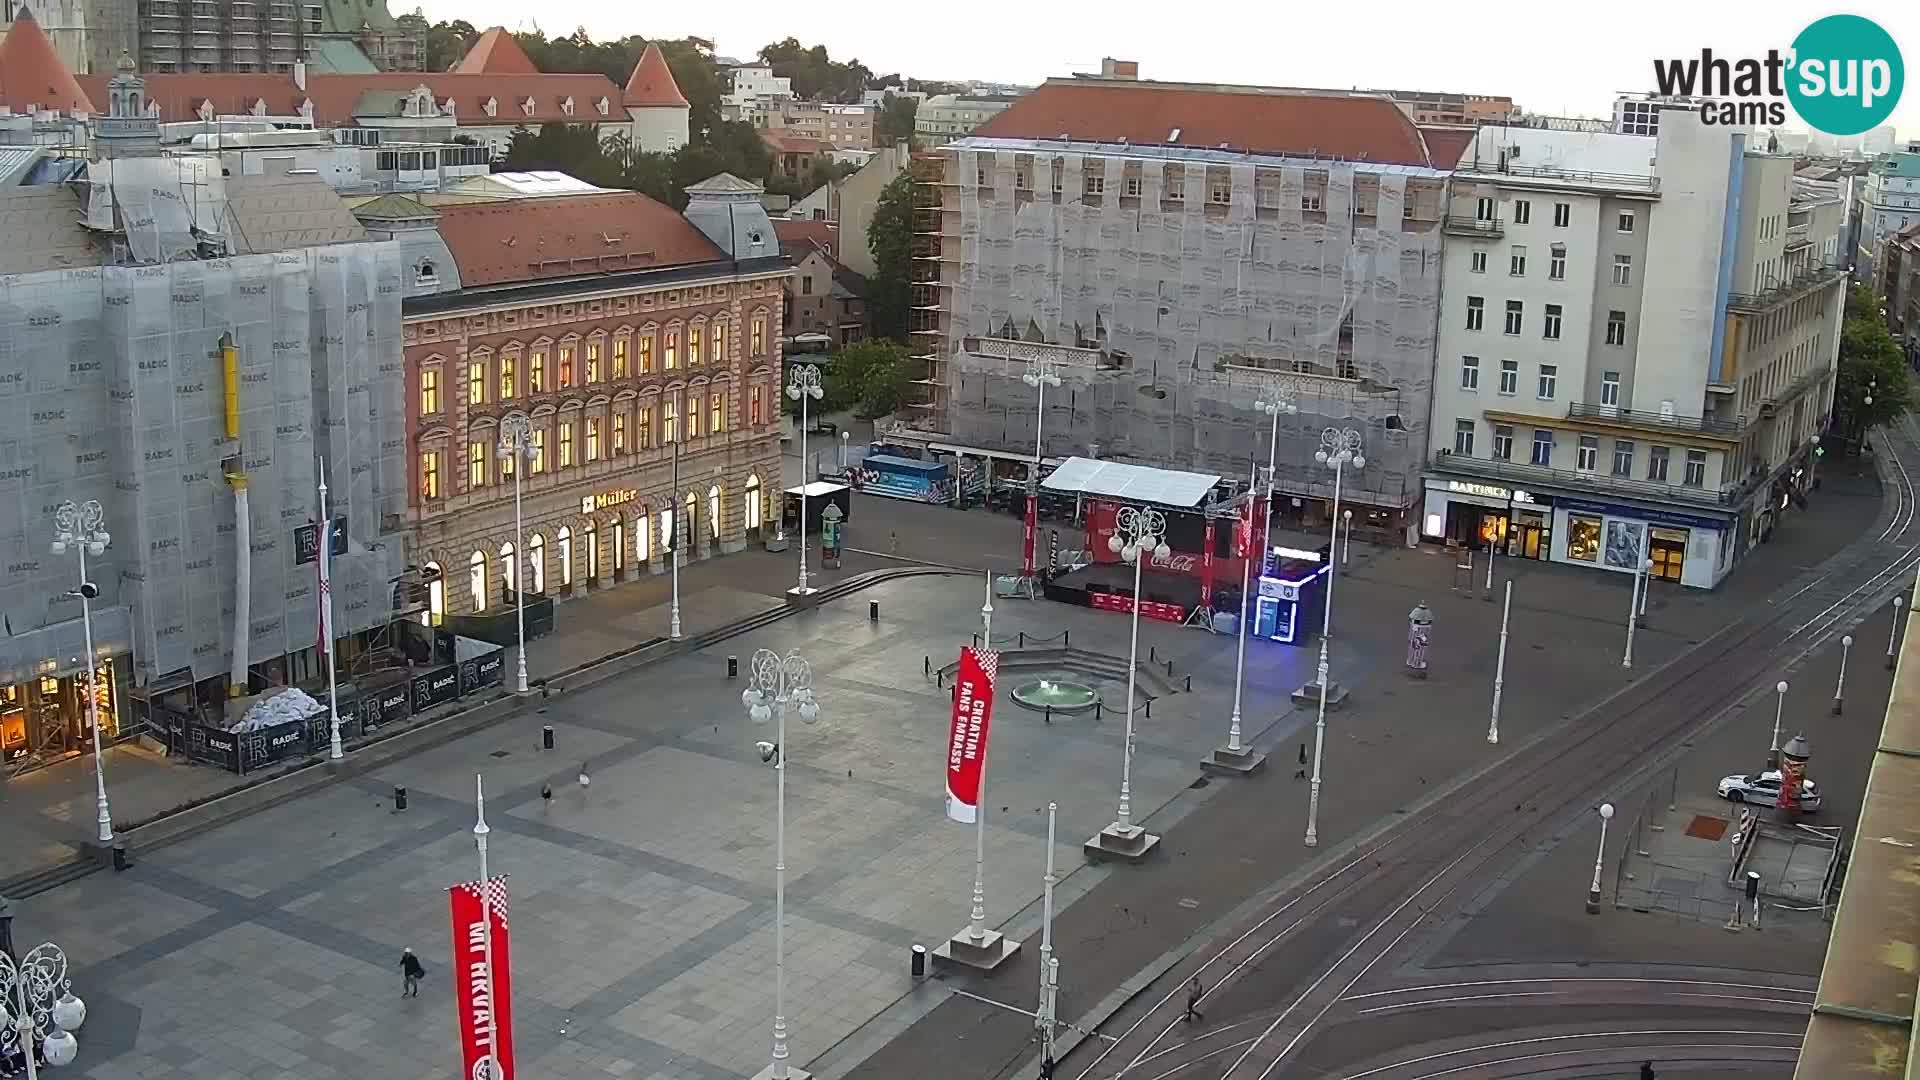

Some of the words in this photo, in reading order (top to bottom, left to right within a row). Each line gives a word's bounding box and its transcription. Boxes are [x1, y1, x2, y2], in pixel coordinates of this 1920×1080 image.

[596, 489, 637, 509] Müller
[959, 681, 973, 713] FANS
[950, 716, 968, 773] EMBASSY
[964, 700, 985, 760] CROATIAN
[469, 921, 491, 952] MI
